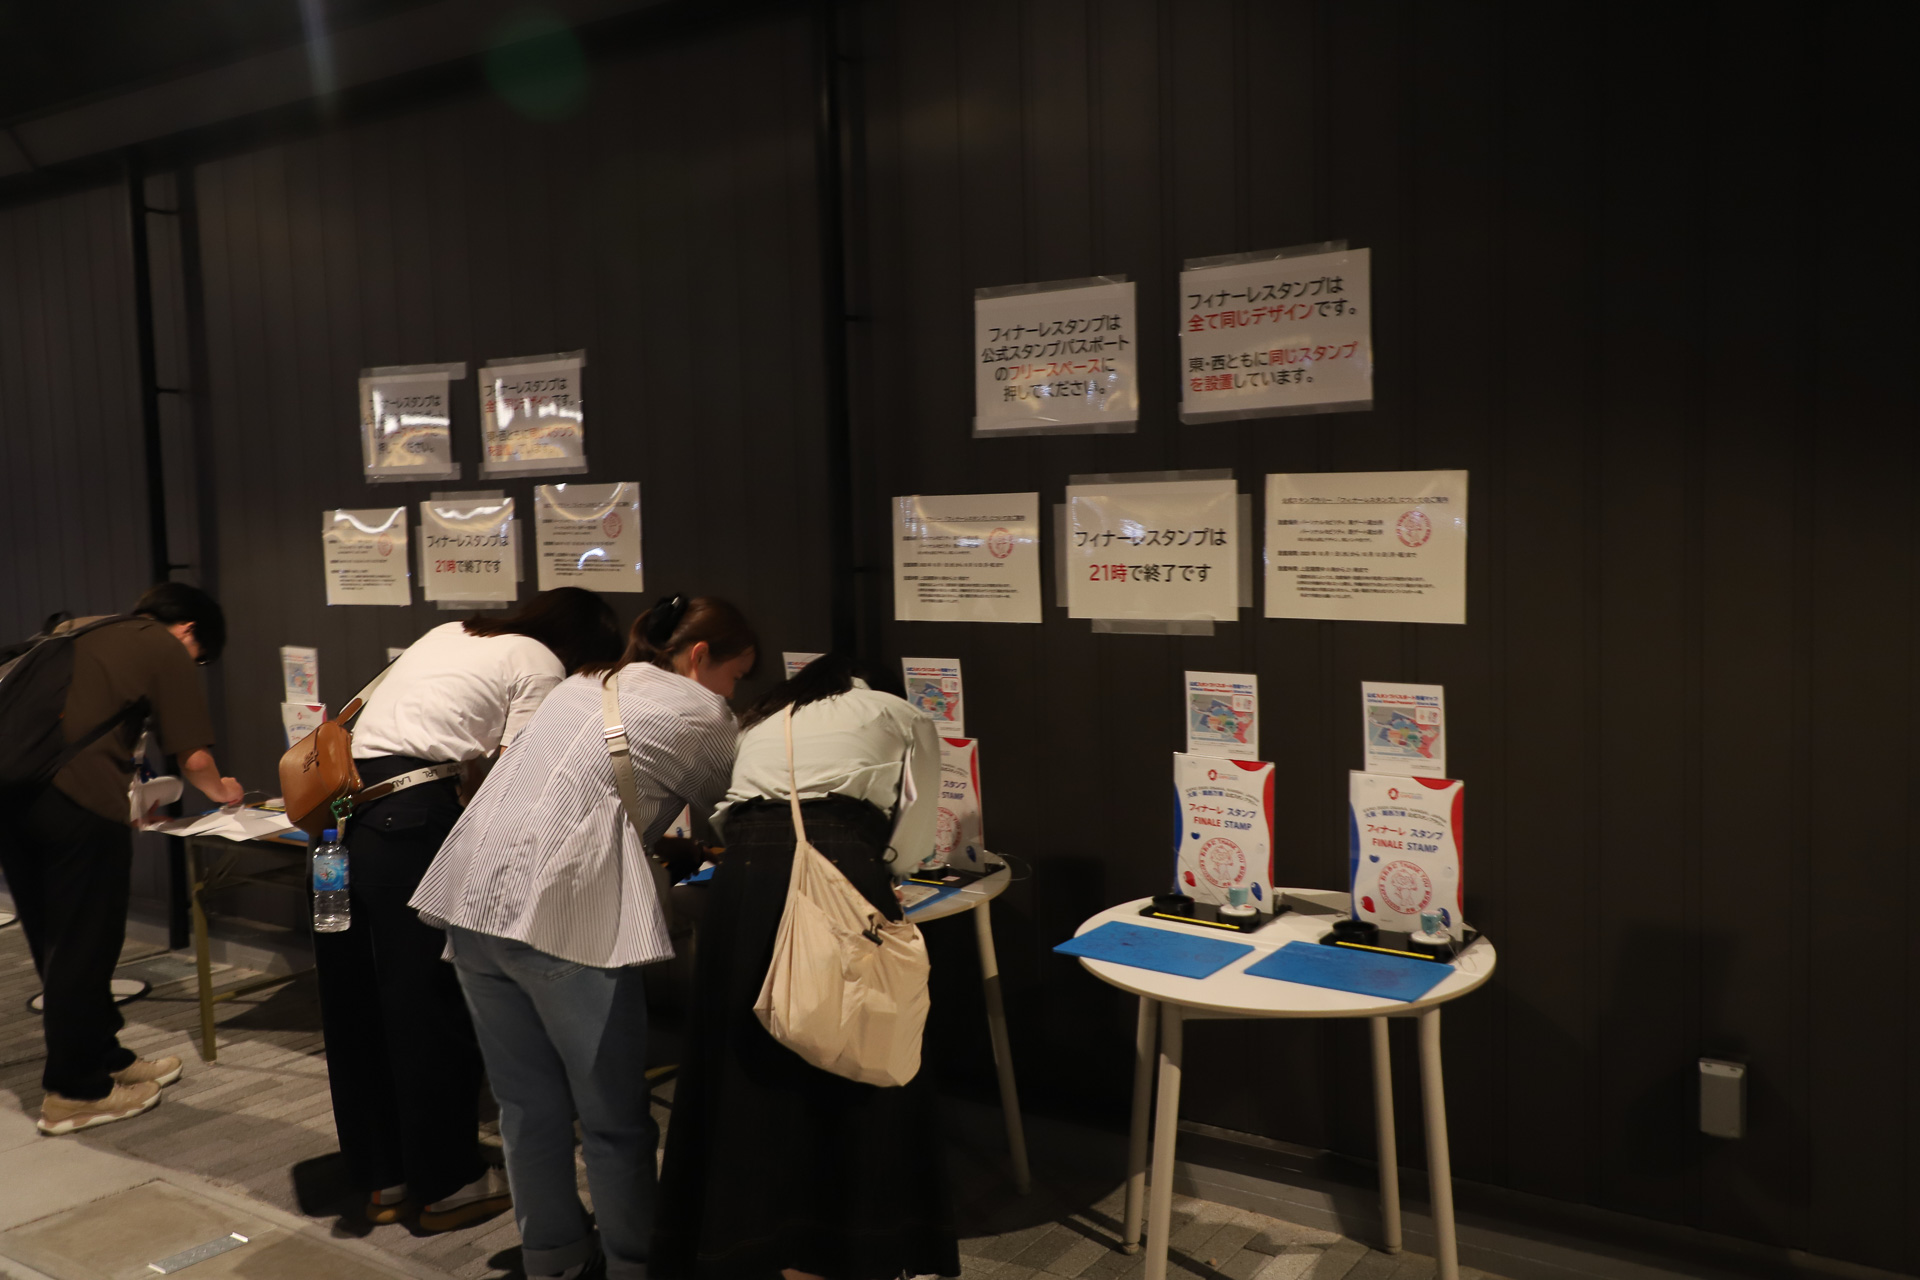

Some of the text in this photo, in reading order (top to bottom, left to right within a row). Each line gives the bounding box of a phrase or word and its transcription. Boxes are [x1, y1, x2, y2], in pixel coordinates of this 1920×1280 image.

[1187, 276, 1344, 309] フィナーレスタンプは
[1188, 298, 1356, 332] 全て同じデザインです。
[989, 314, 1122, 342] フィナーレスタンプは
[981, 335, 1130, 363] 公式スタンプパスポート
[1188, 341, 1358, 373] 東・西ともに同じスタンプ
[995, 358, 1116, 381] のフリースペースに
[1190, 369, 1314, 392] を設置しています。
[1075, 527, 1228, 548] フィナーレスタンプは
[435, 559, 501, 574] 21時で終了です
[1089, 563, 1212, 583] 21時で終了です
[941, 791, 964, 800] STAMP
[1189, 803, 1257, 818] フィナーレ スタンプ
[1193, 816, 1252, 831] FINALE STAMP
[1366, 823, 1444, 840] フィナーレ スタンプ
[1372, 838, 1439, 853] FINALE STAMP
